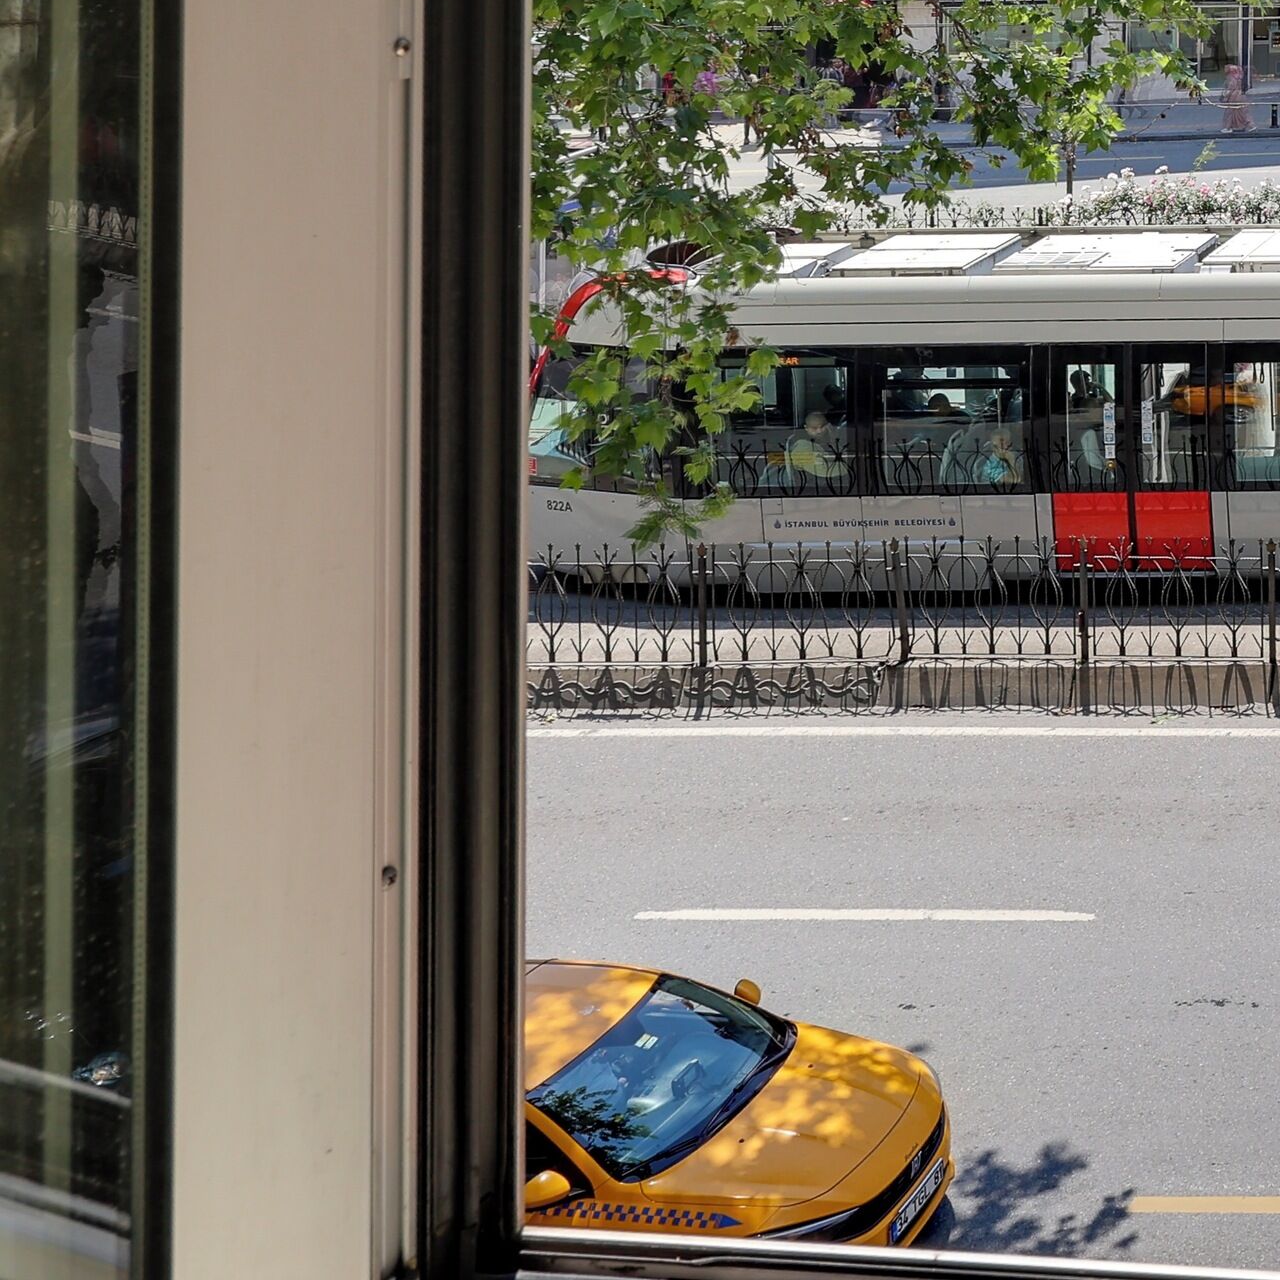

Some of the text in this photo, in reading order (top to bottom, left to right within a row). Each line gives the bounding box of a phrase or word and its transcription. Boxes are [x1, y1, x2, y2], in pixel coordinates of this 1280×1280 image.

[546, 500, 572, 512] 822A
[784, 518, 946, 528] İSTANBUL BÜYÜKŞEHİR BELEDİYESİ
